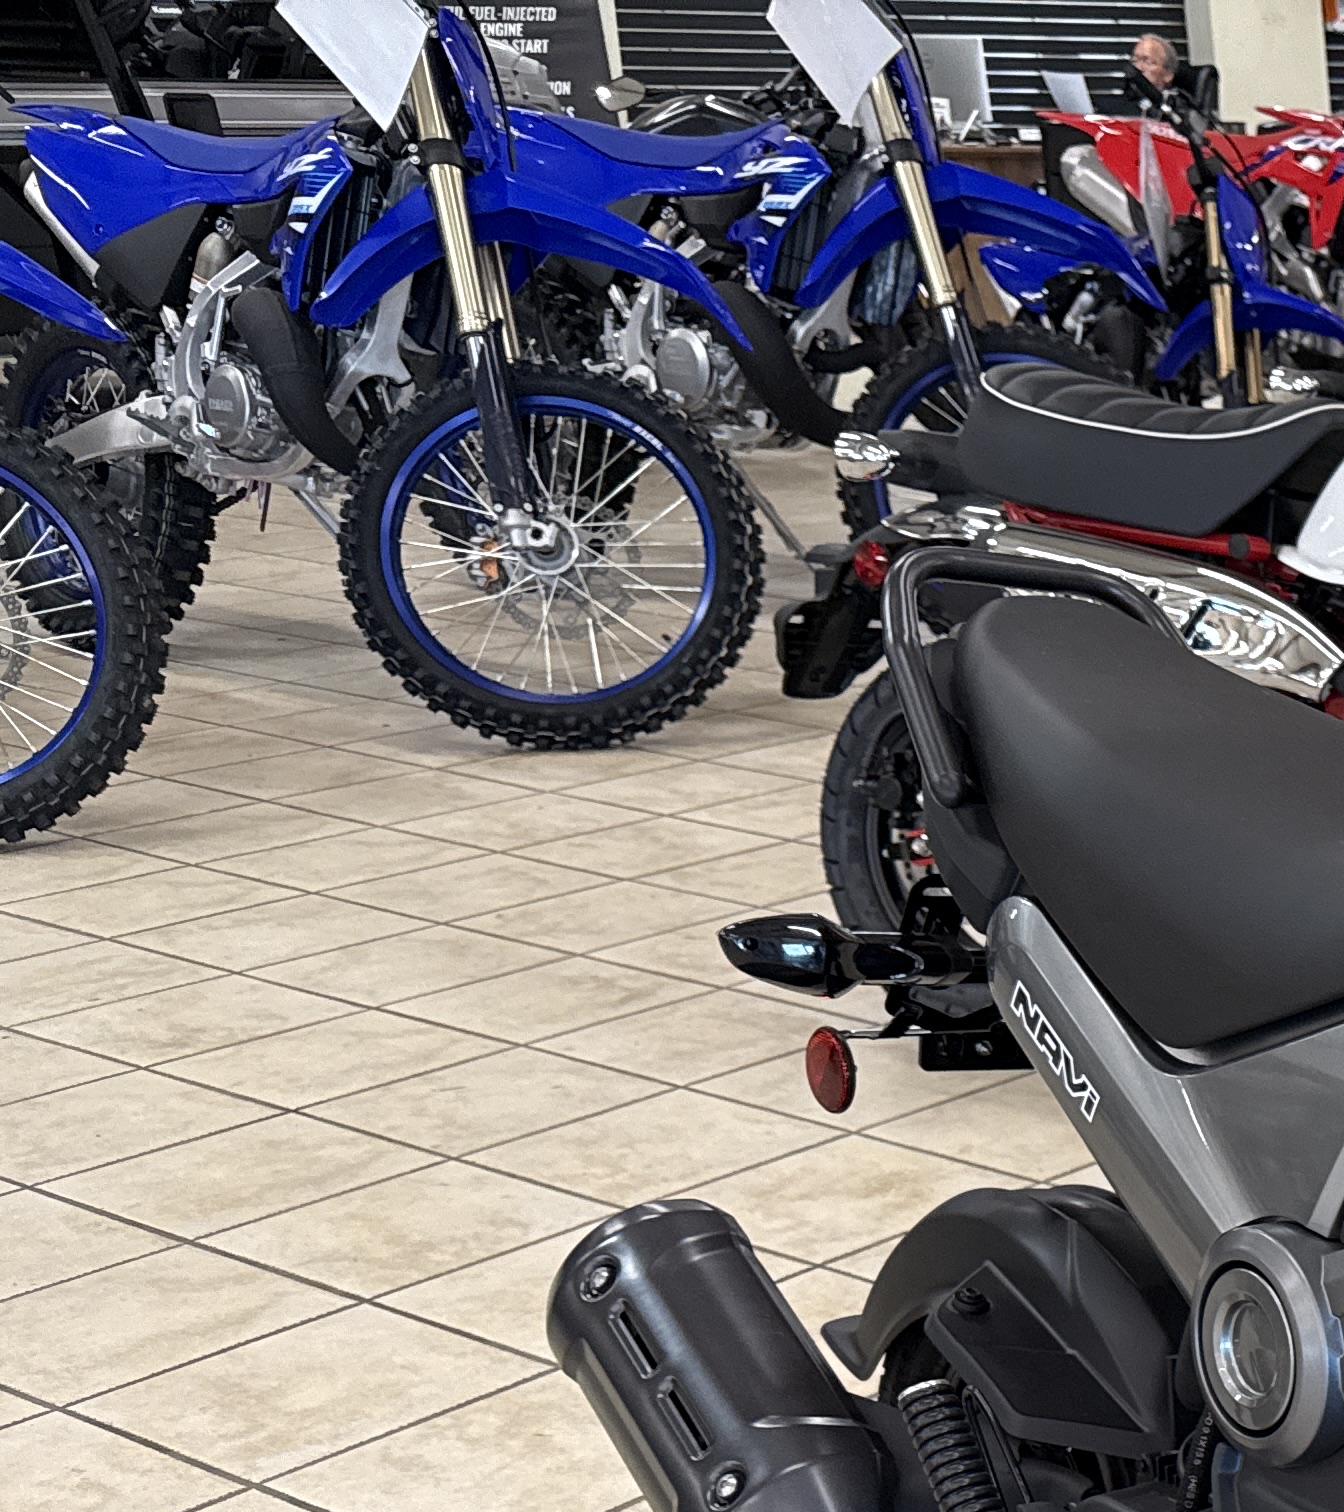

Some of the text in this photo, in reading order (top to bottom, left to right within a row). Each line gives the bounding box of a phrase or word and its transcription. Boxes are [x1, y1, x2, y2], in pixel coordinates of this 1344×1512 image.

[469, 6, 557, 21] FUEL-INJECTED
[480, 22, 524, 37] ENGINE
[511, 39, 550, 53] START
